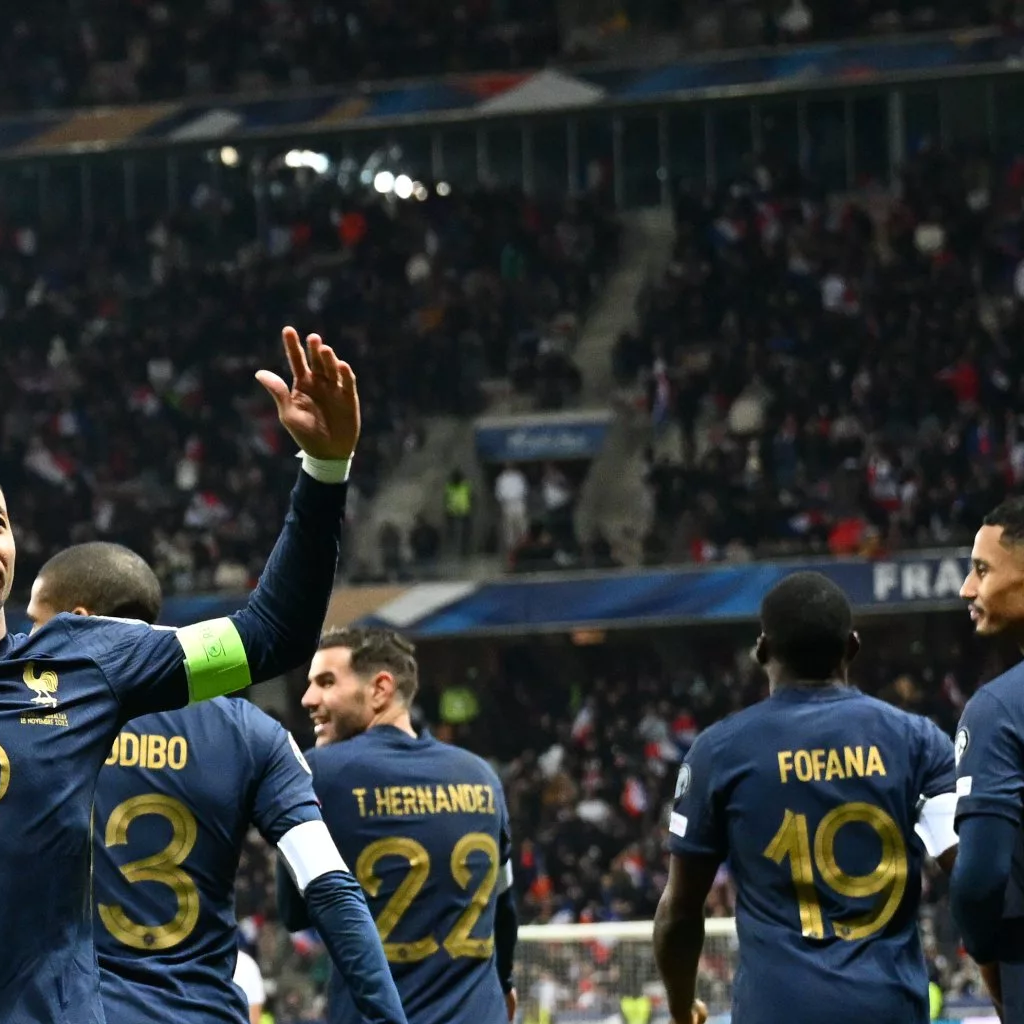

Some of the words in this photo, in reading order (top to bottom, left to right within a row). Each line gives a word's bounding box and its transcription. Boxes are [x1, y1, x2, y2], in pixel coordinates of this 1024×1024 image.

[873, 559, 963, 601] FRA
[778, 746, 887, 783] FOFANA
[97, 793, 200, 950] 3
[356, 832, 500, 962] 22
[763, 802, 908, 941] 19
